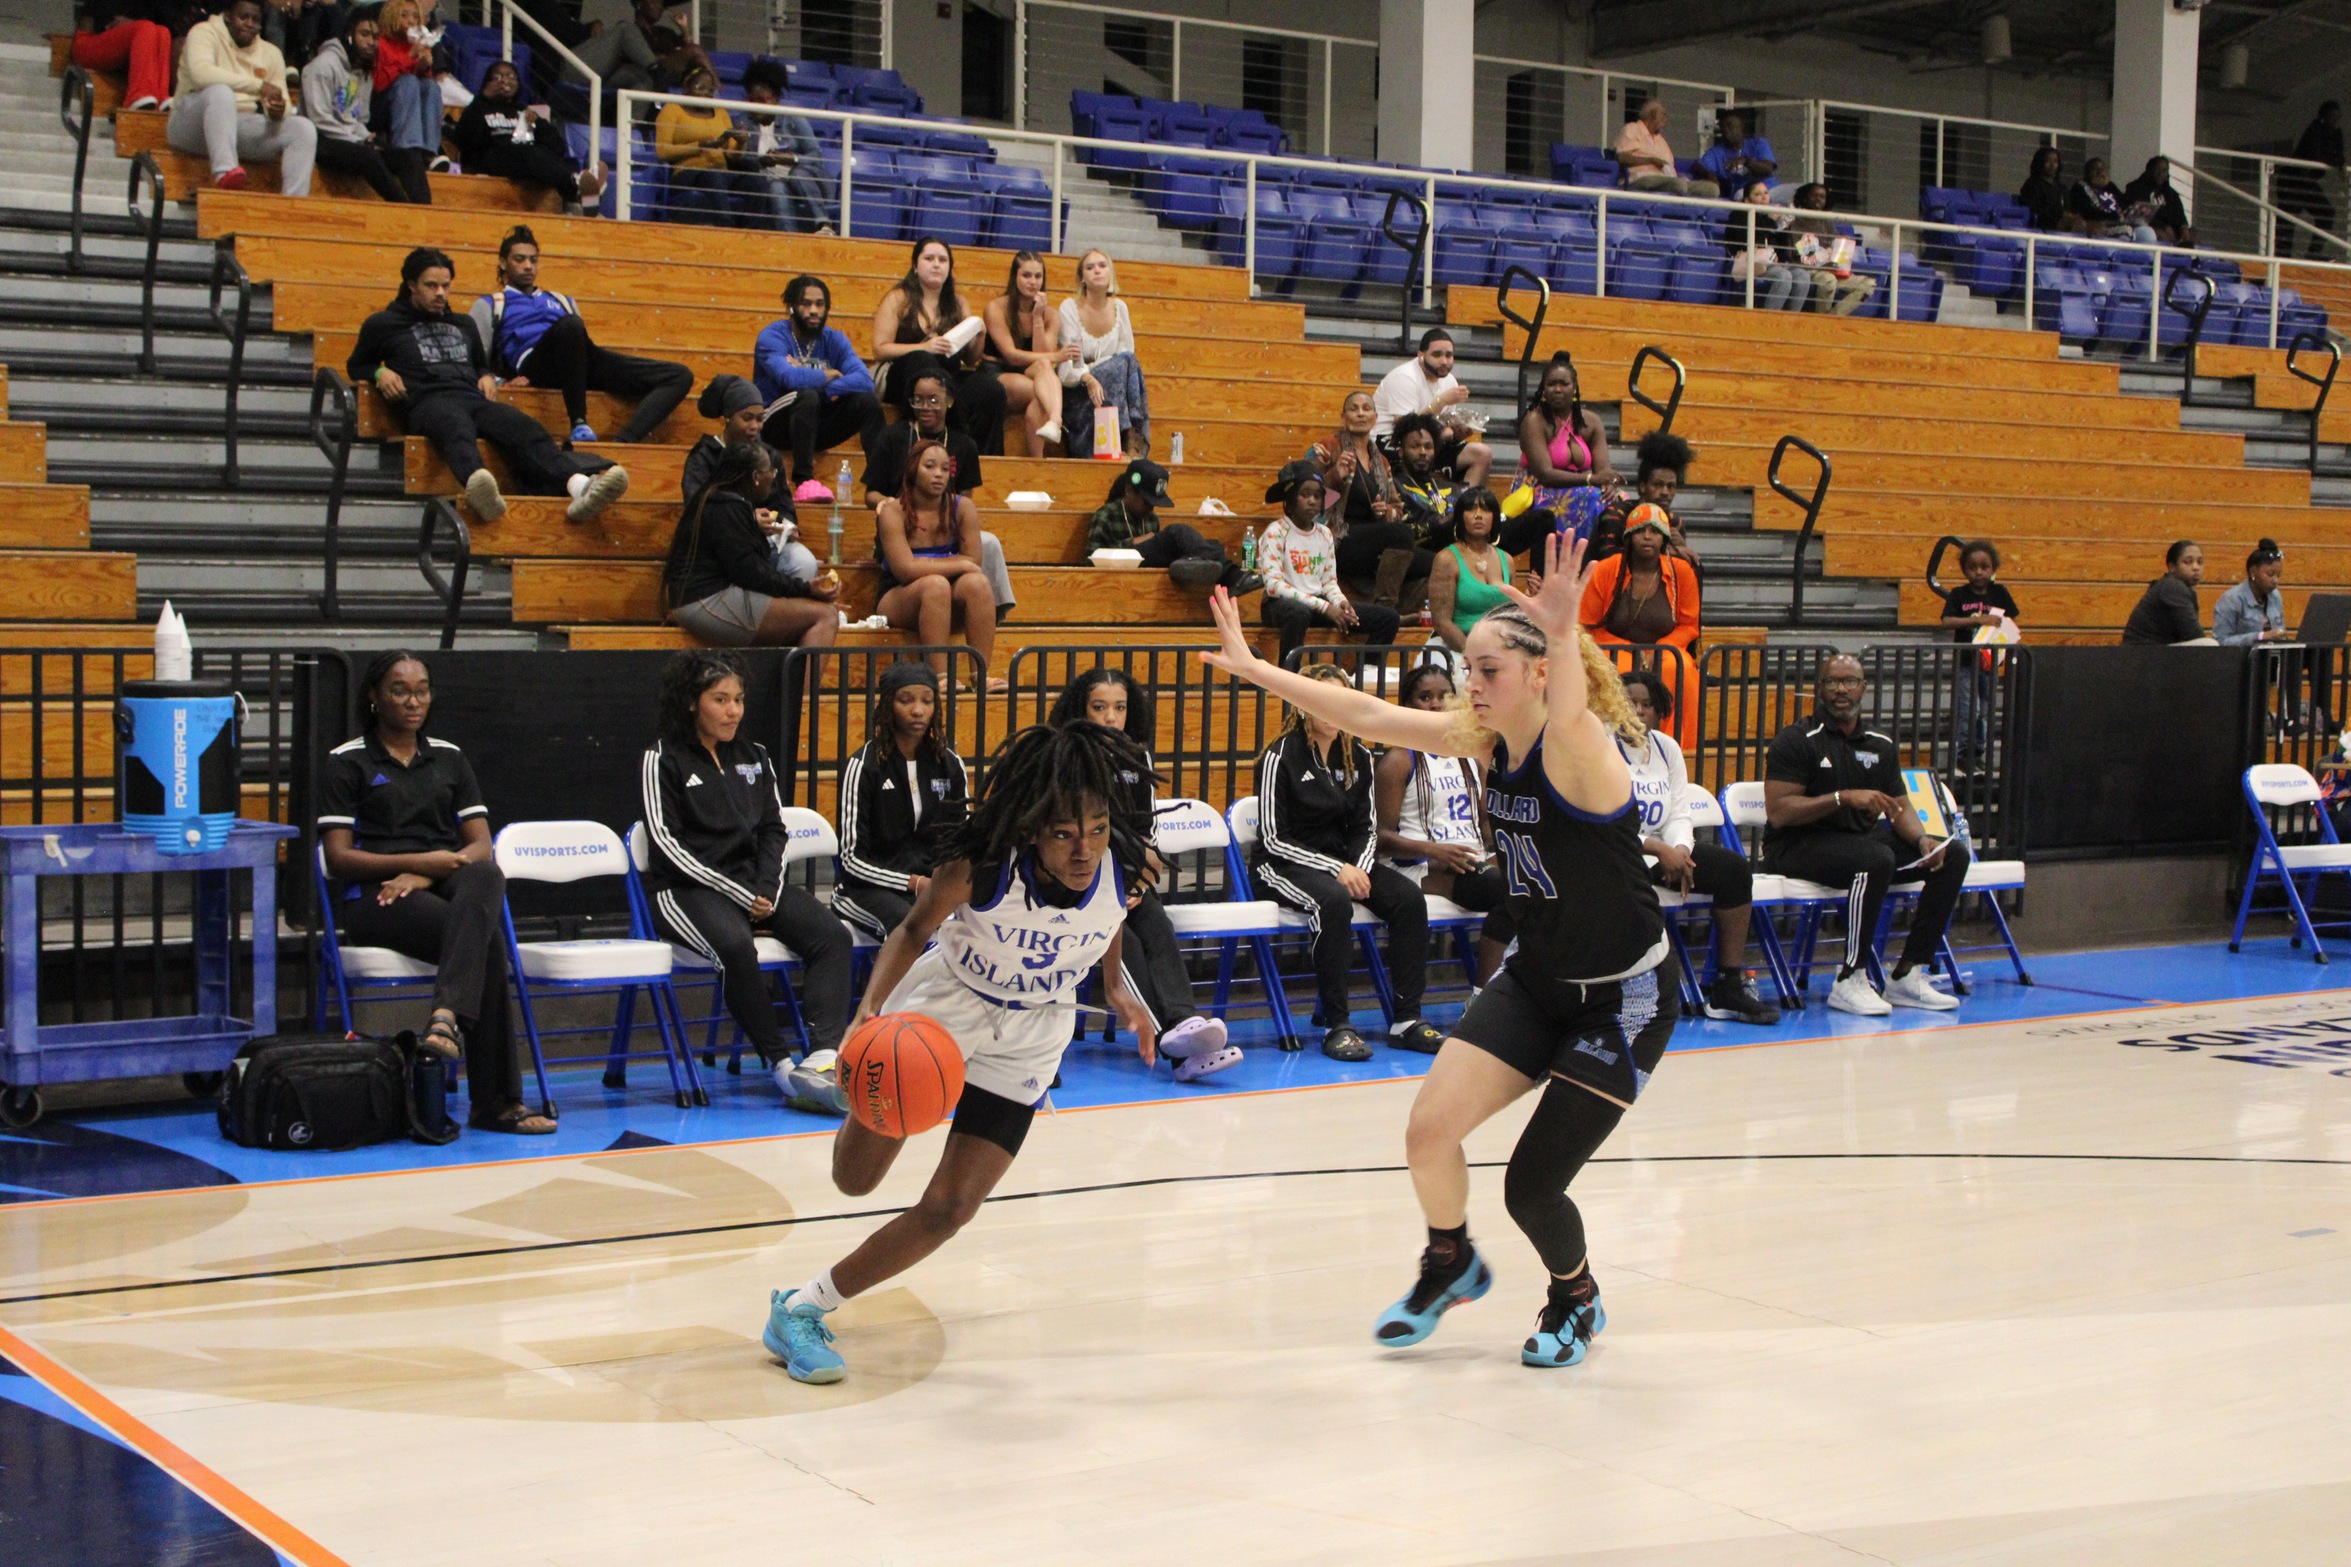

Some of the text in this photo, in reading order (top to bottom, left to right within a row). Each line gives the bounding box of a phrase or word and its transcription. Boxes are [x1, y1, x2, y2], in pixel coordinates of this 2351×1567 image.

[174, 708, 187, 808] POWERADE
[1447, 794, 1473, 820] 12
[1486, 788, 1541, 823] DILLARD
[514, 844, 608, 857] UVISPORTS.COM
[1495, 829, 1558, 898] 24
[993, 923, 1112, 953] VIRGIN
[959, 945, 1086, 992] ISLAND
